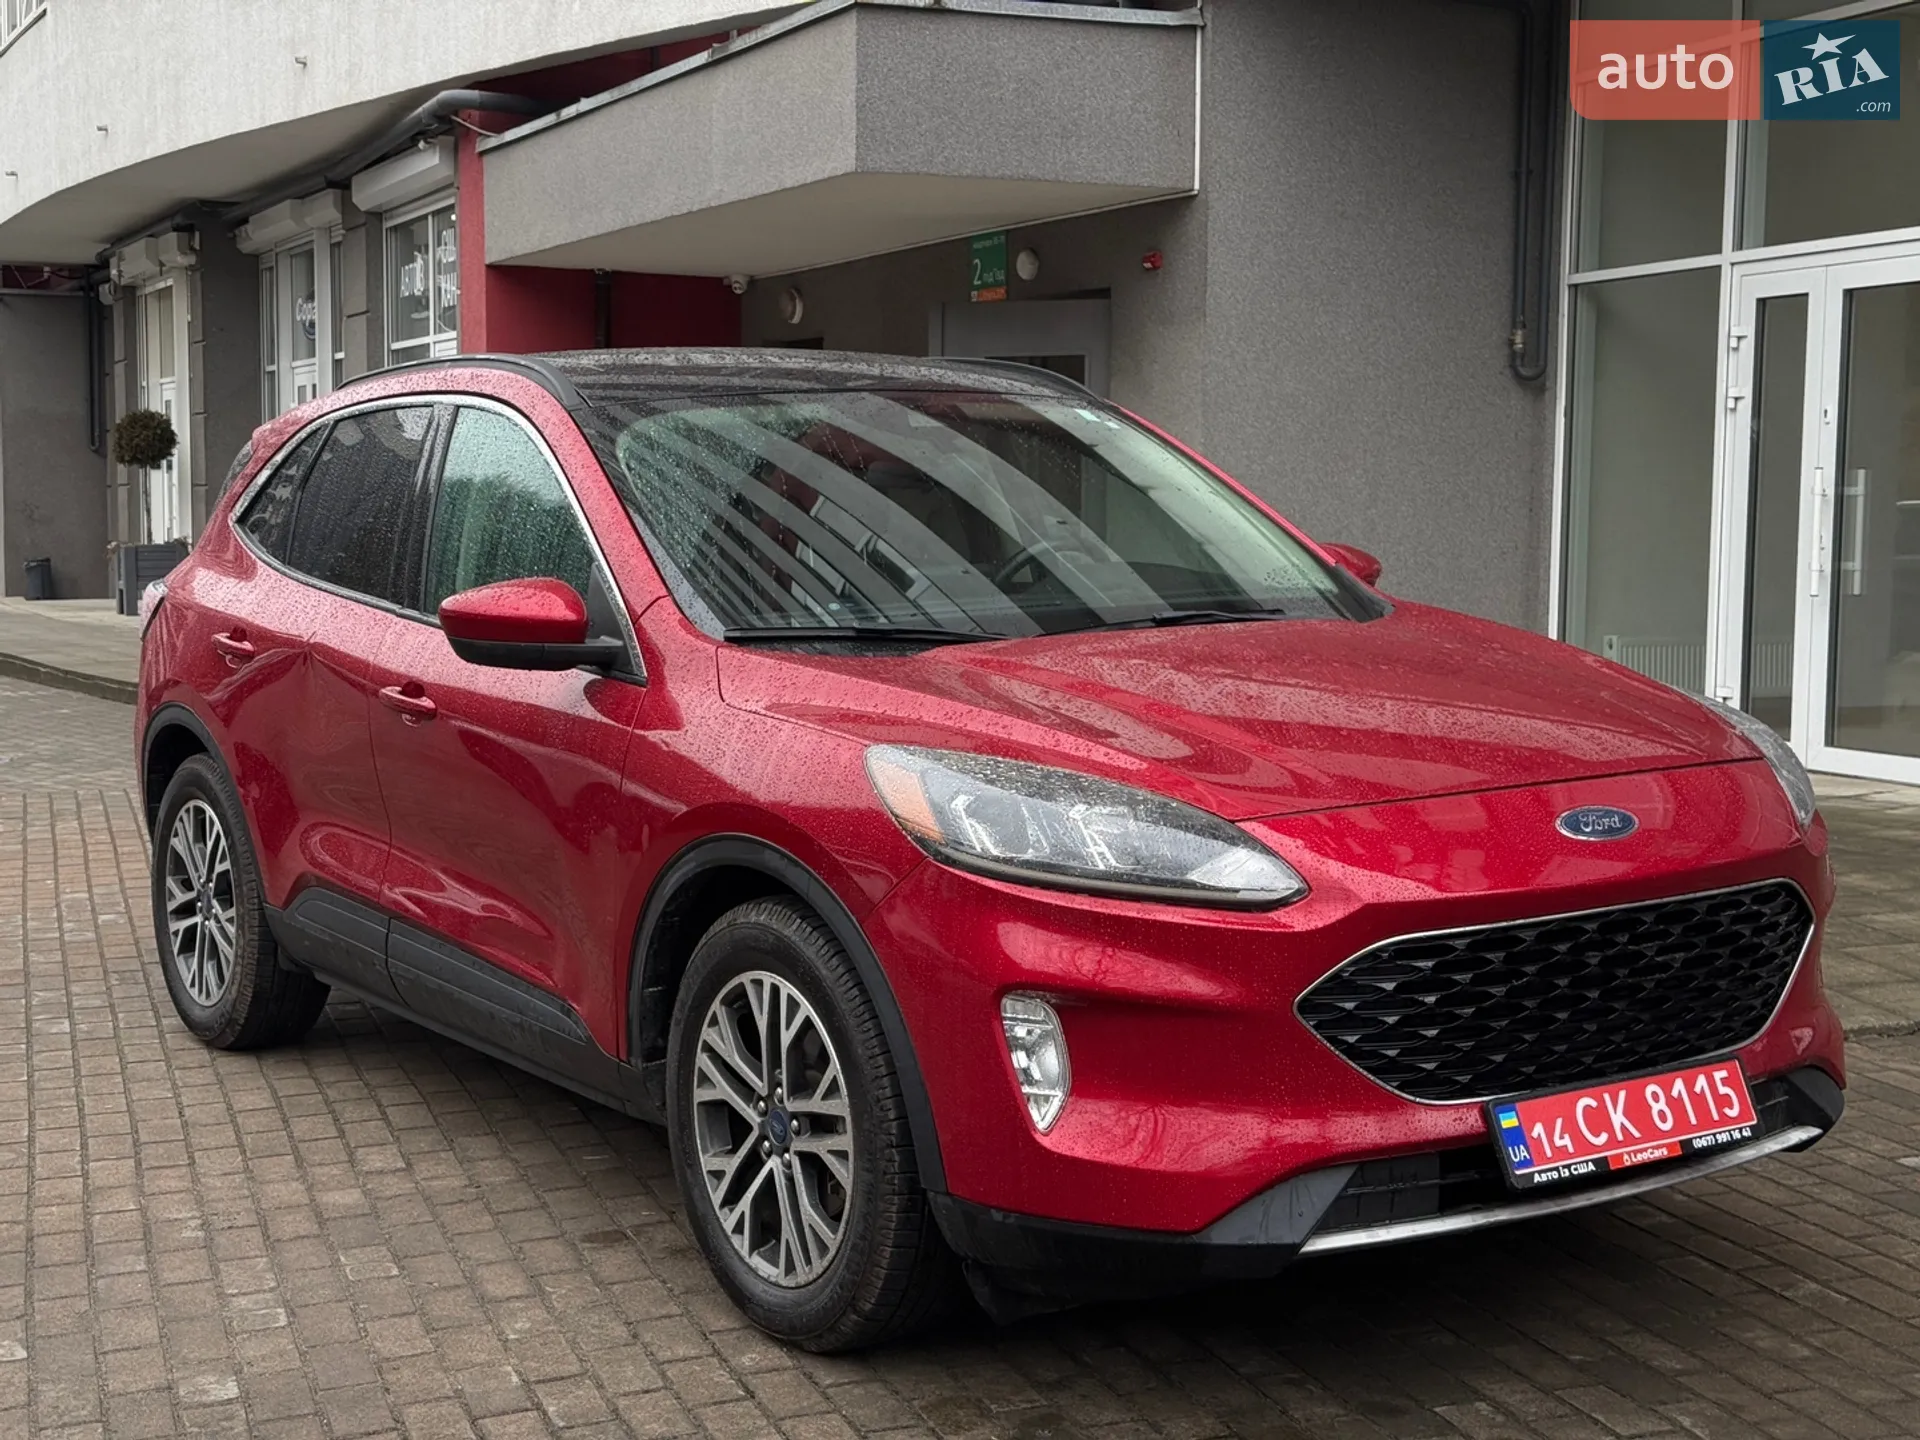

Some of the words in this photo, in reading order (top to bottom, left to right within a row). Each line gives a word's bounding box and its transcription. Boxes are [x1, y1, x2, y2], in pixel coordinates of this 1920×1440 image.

[973, 258, 982, 285] 2
[1579, 811, 1622, 832] Ford
[1644, 1069, 1740, 1132] 8115
[1691, 1134, 1715, 1149] (067)
[1715, 1131, 1731, 1144] 991
[1730, 1129, 1741, 1140] 16
[1510, 1143, 1530, 1163] UA
[1631, 1146, 1668, 1162] LeoCars
[1533, 1170, 1559, 1183] Авто
[1571, 1162, 1596, 1175] США
